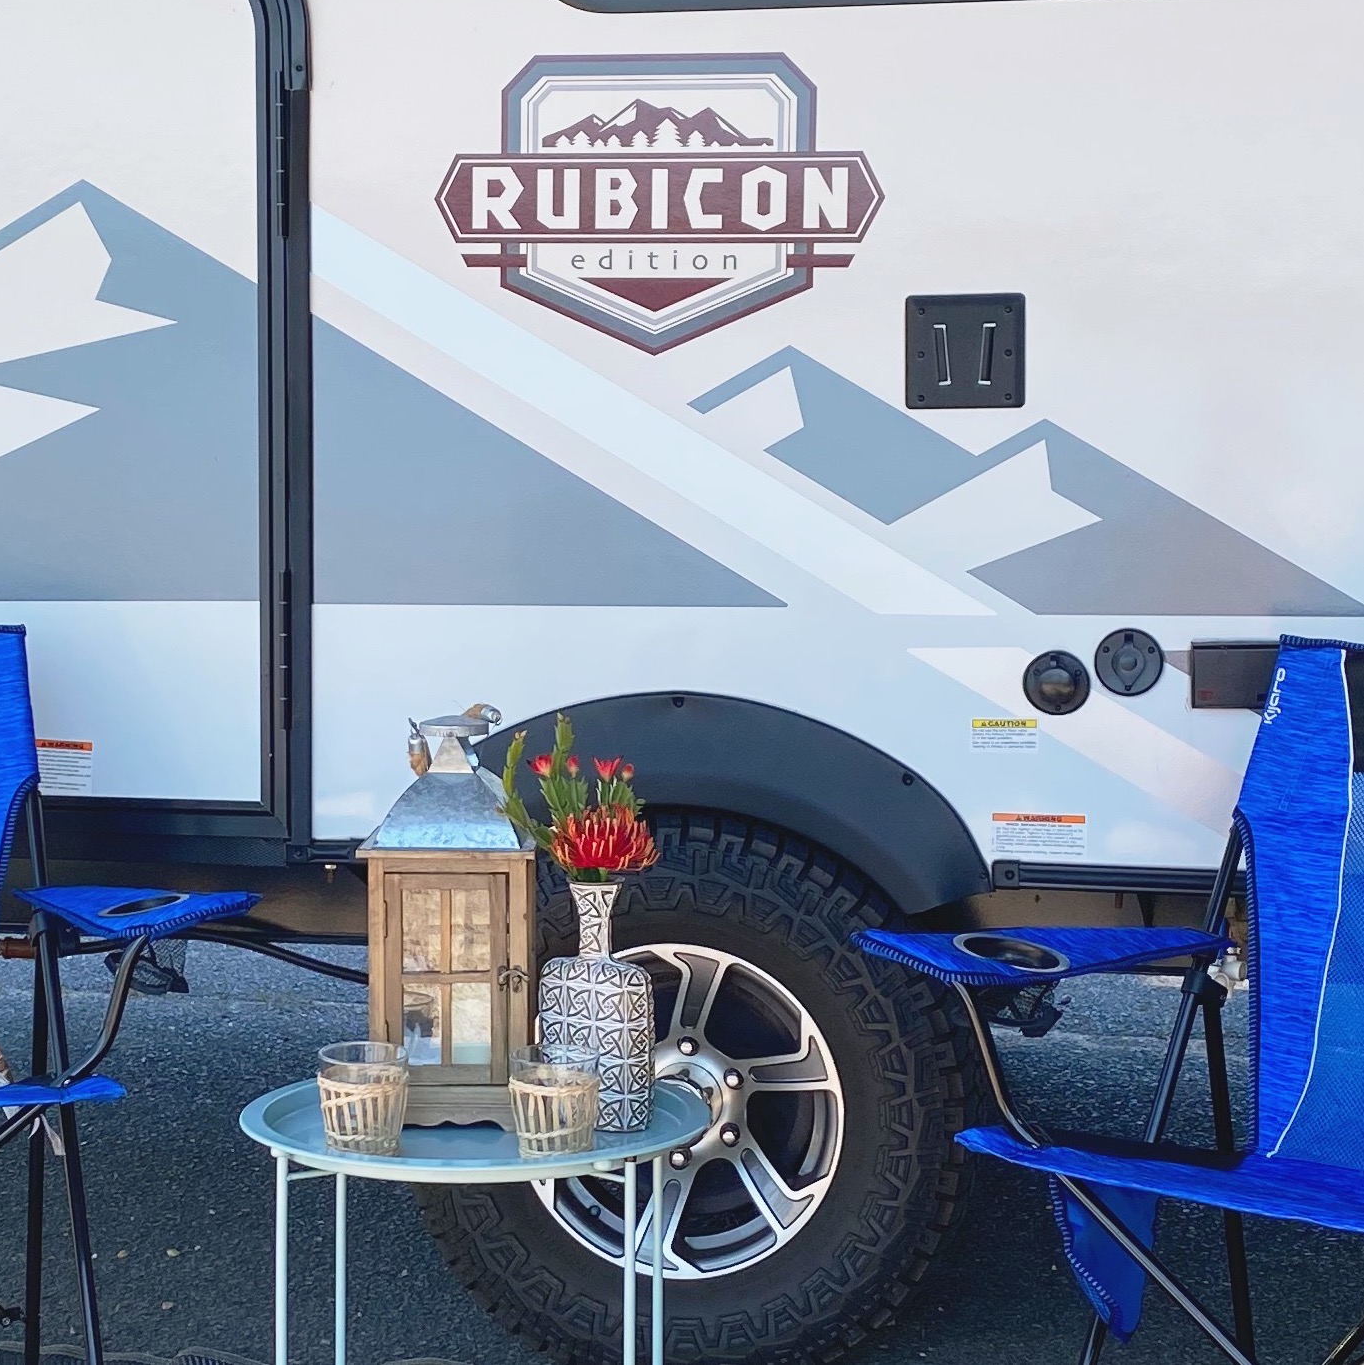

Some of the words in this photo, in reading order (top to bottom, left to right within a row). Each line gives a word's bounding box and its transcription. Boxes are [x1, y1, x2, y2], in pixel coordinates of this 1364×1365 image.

[471, 165, 849, 231] RUBICON
[570, 249, 738, 271] edition
[1263, 667, 1286, 725] Kijaro
